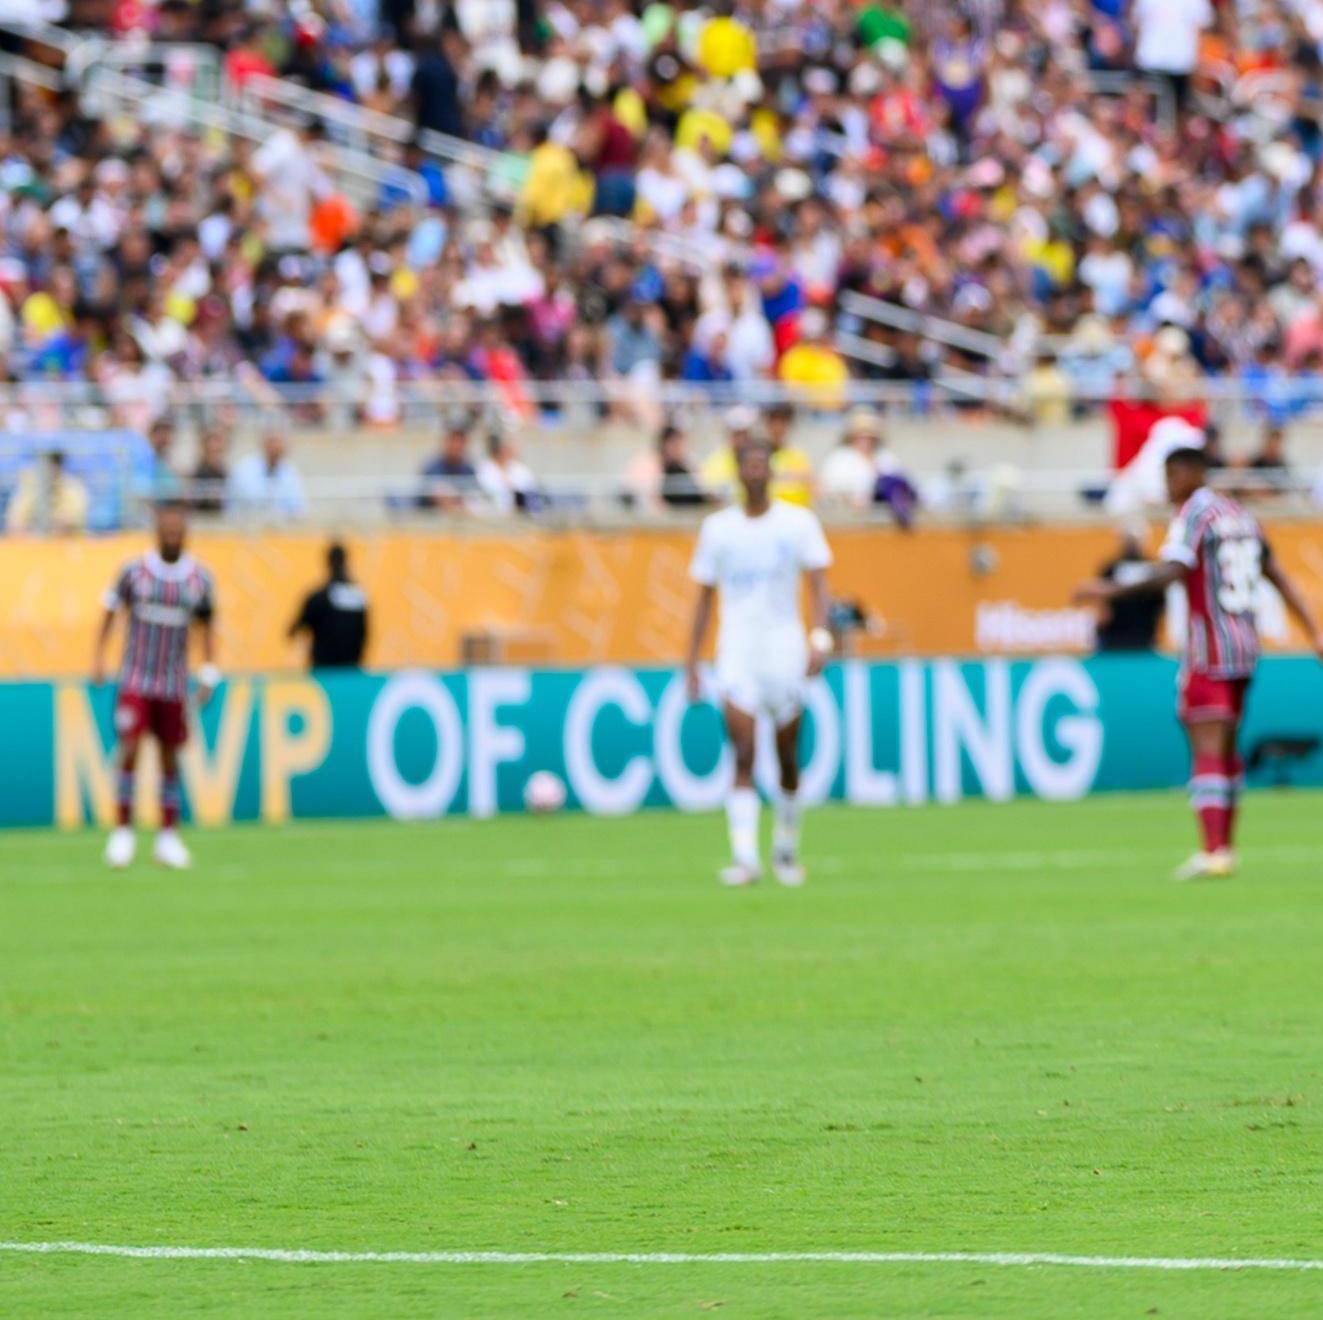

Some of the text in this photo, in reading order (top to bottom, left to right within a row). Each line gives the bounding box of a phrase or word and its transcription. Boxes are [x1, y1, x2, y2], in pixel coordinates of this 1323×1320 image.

[55, 654, 1103, 834] MVP OF COOLING
